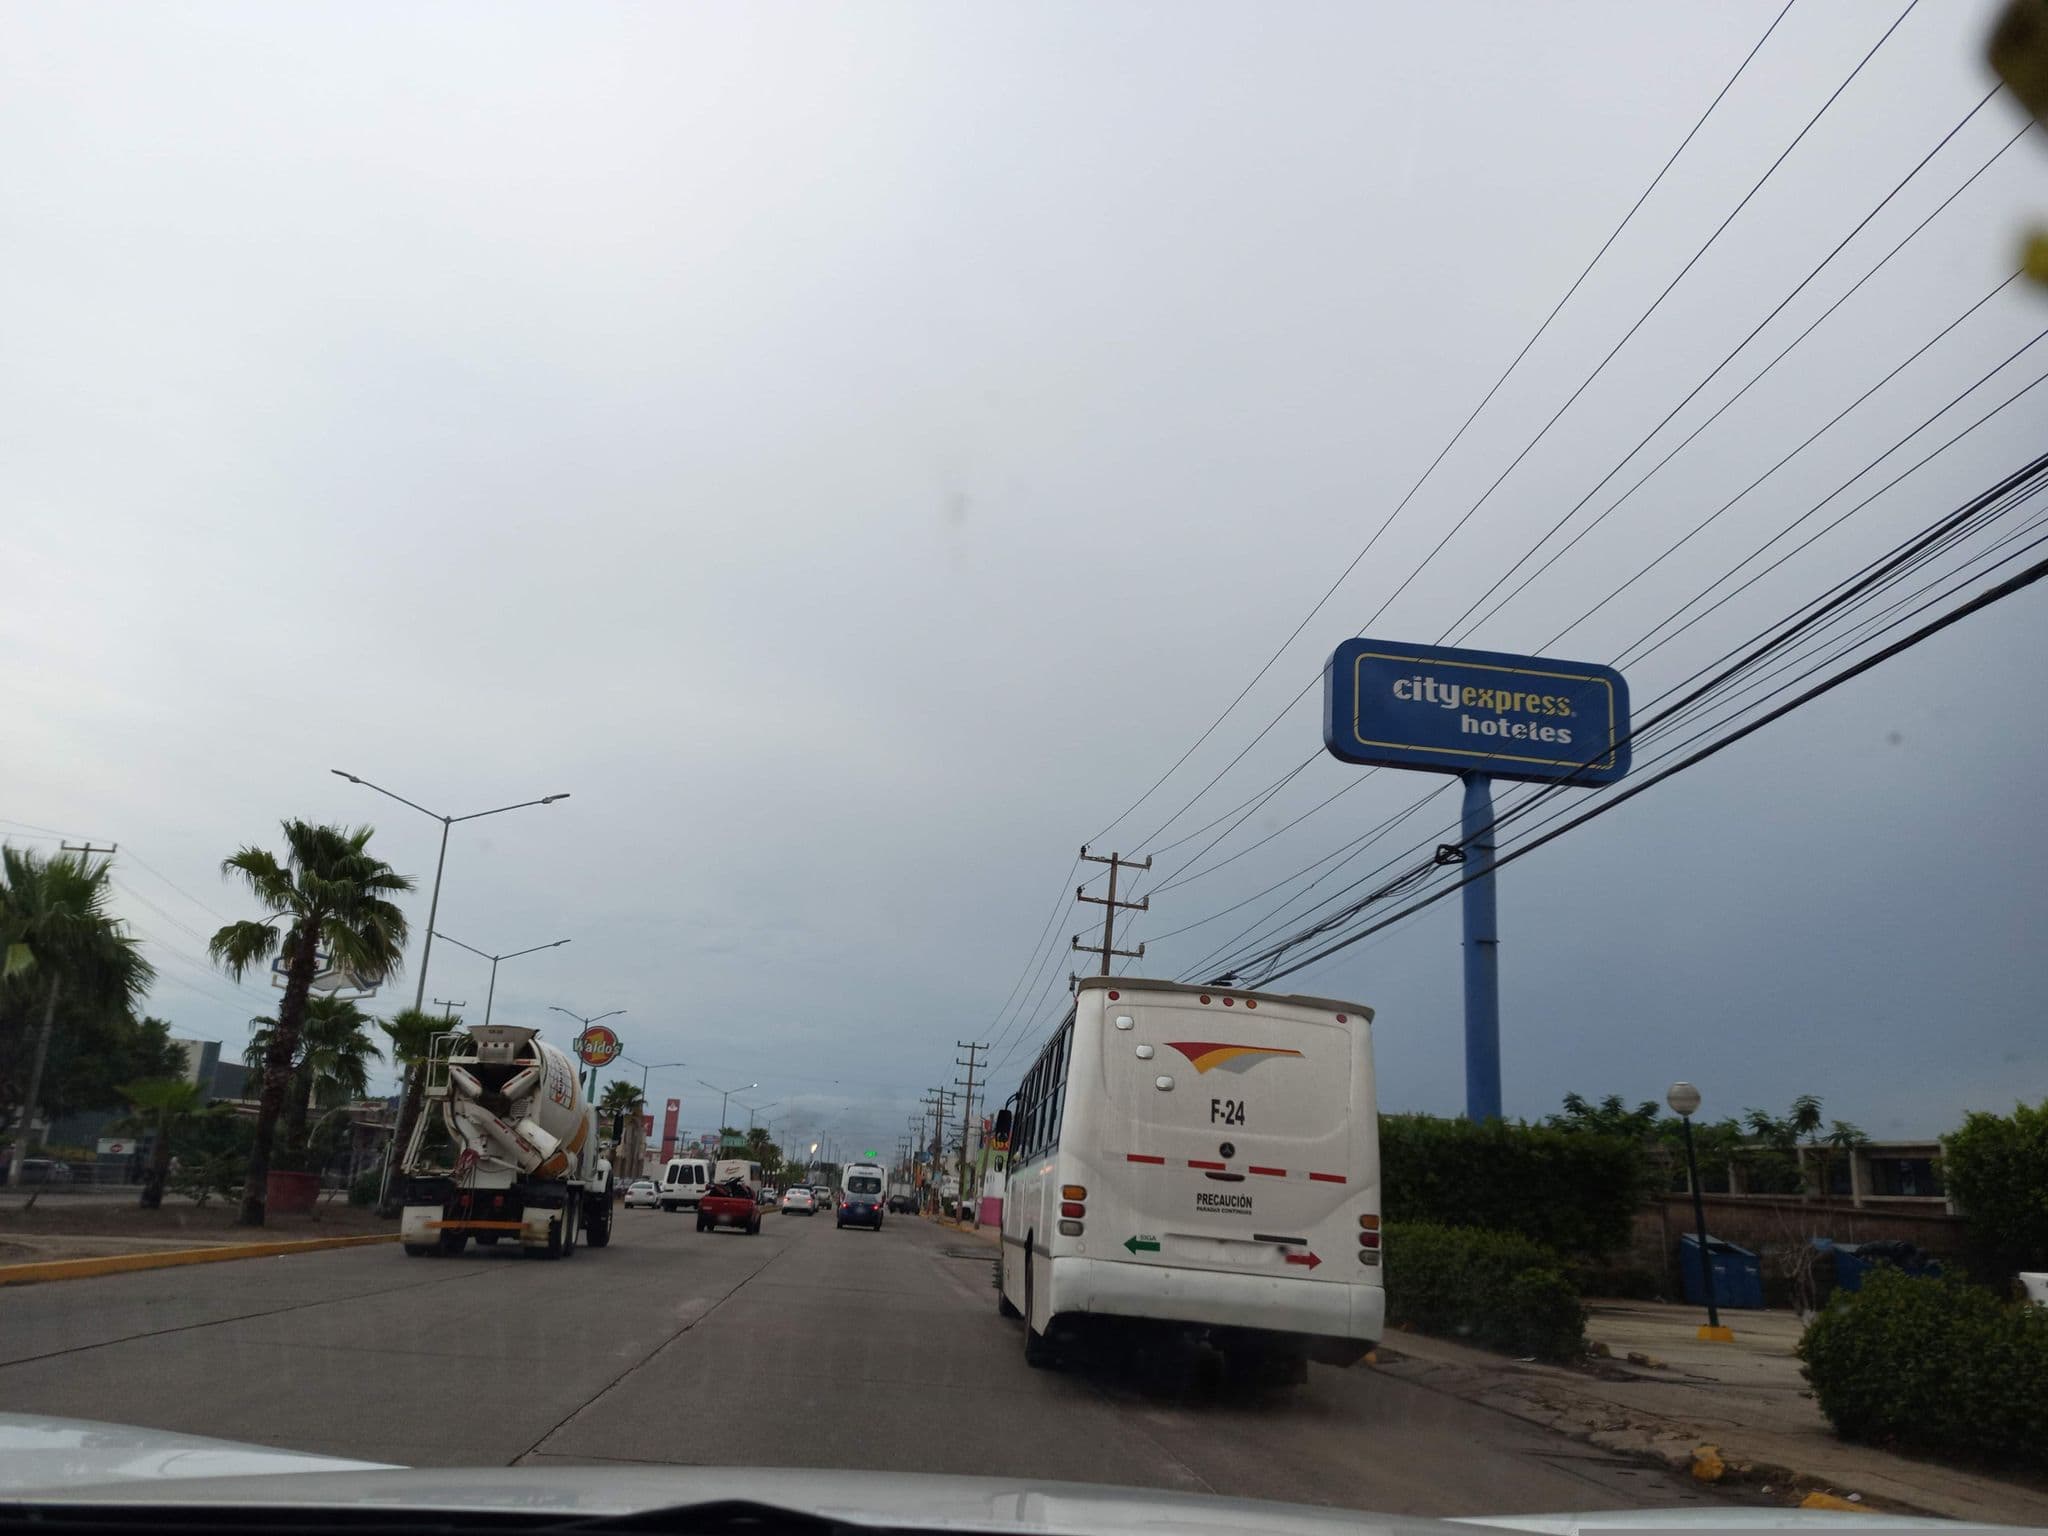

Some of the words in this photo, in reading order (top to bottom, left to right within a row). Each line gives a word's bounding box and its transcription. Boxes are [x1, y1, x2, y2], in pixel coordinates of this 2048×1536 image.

[1460, 714, 1573, 744] hoteles
[1211, 1098, 1246, 1126] F-24
[1196, 1192, 1253, 1208] PRECAUCIÓN
